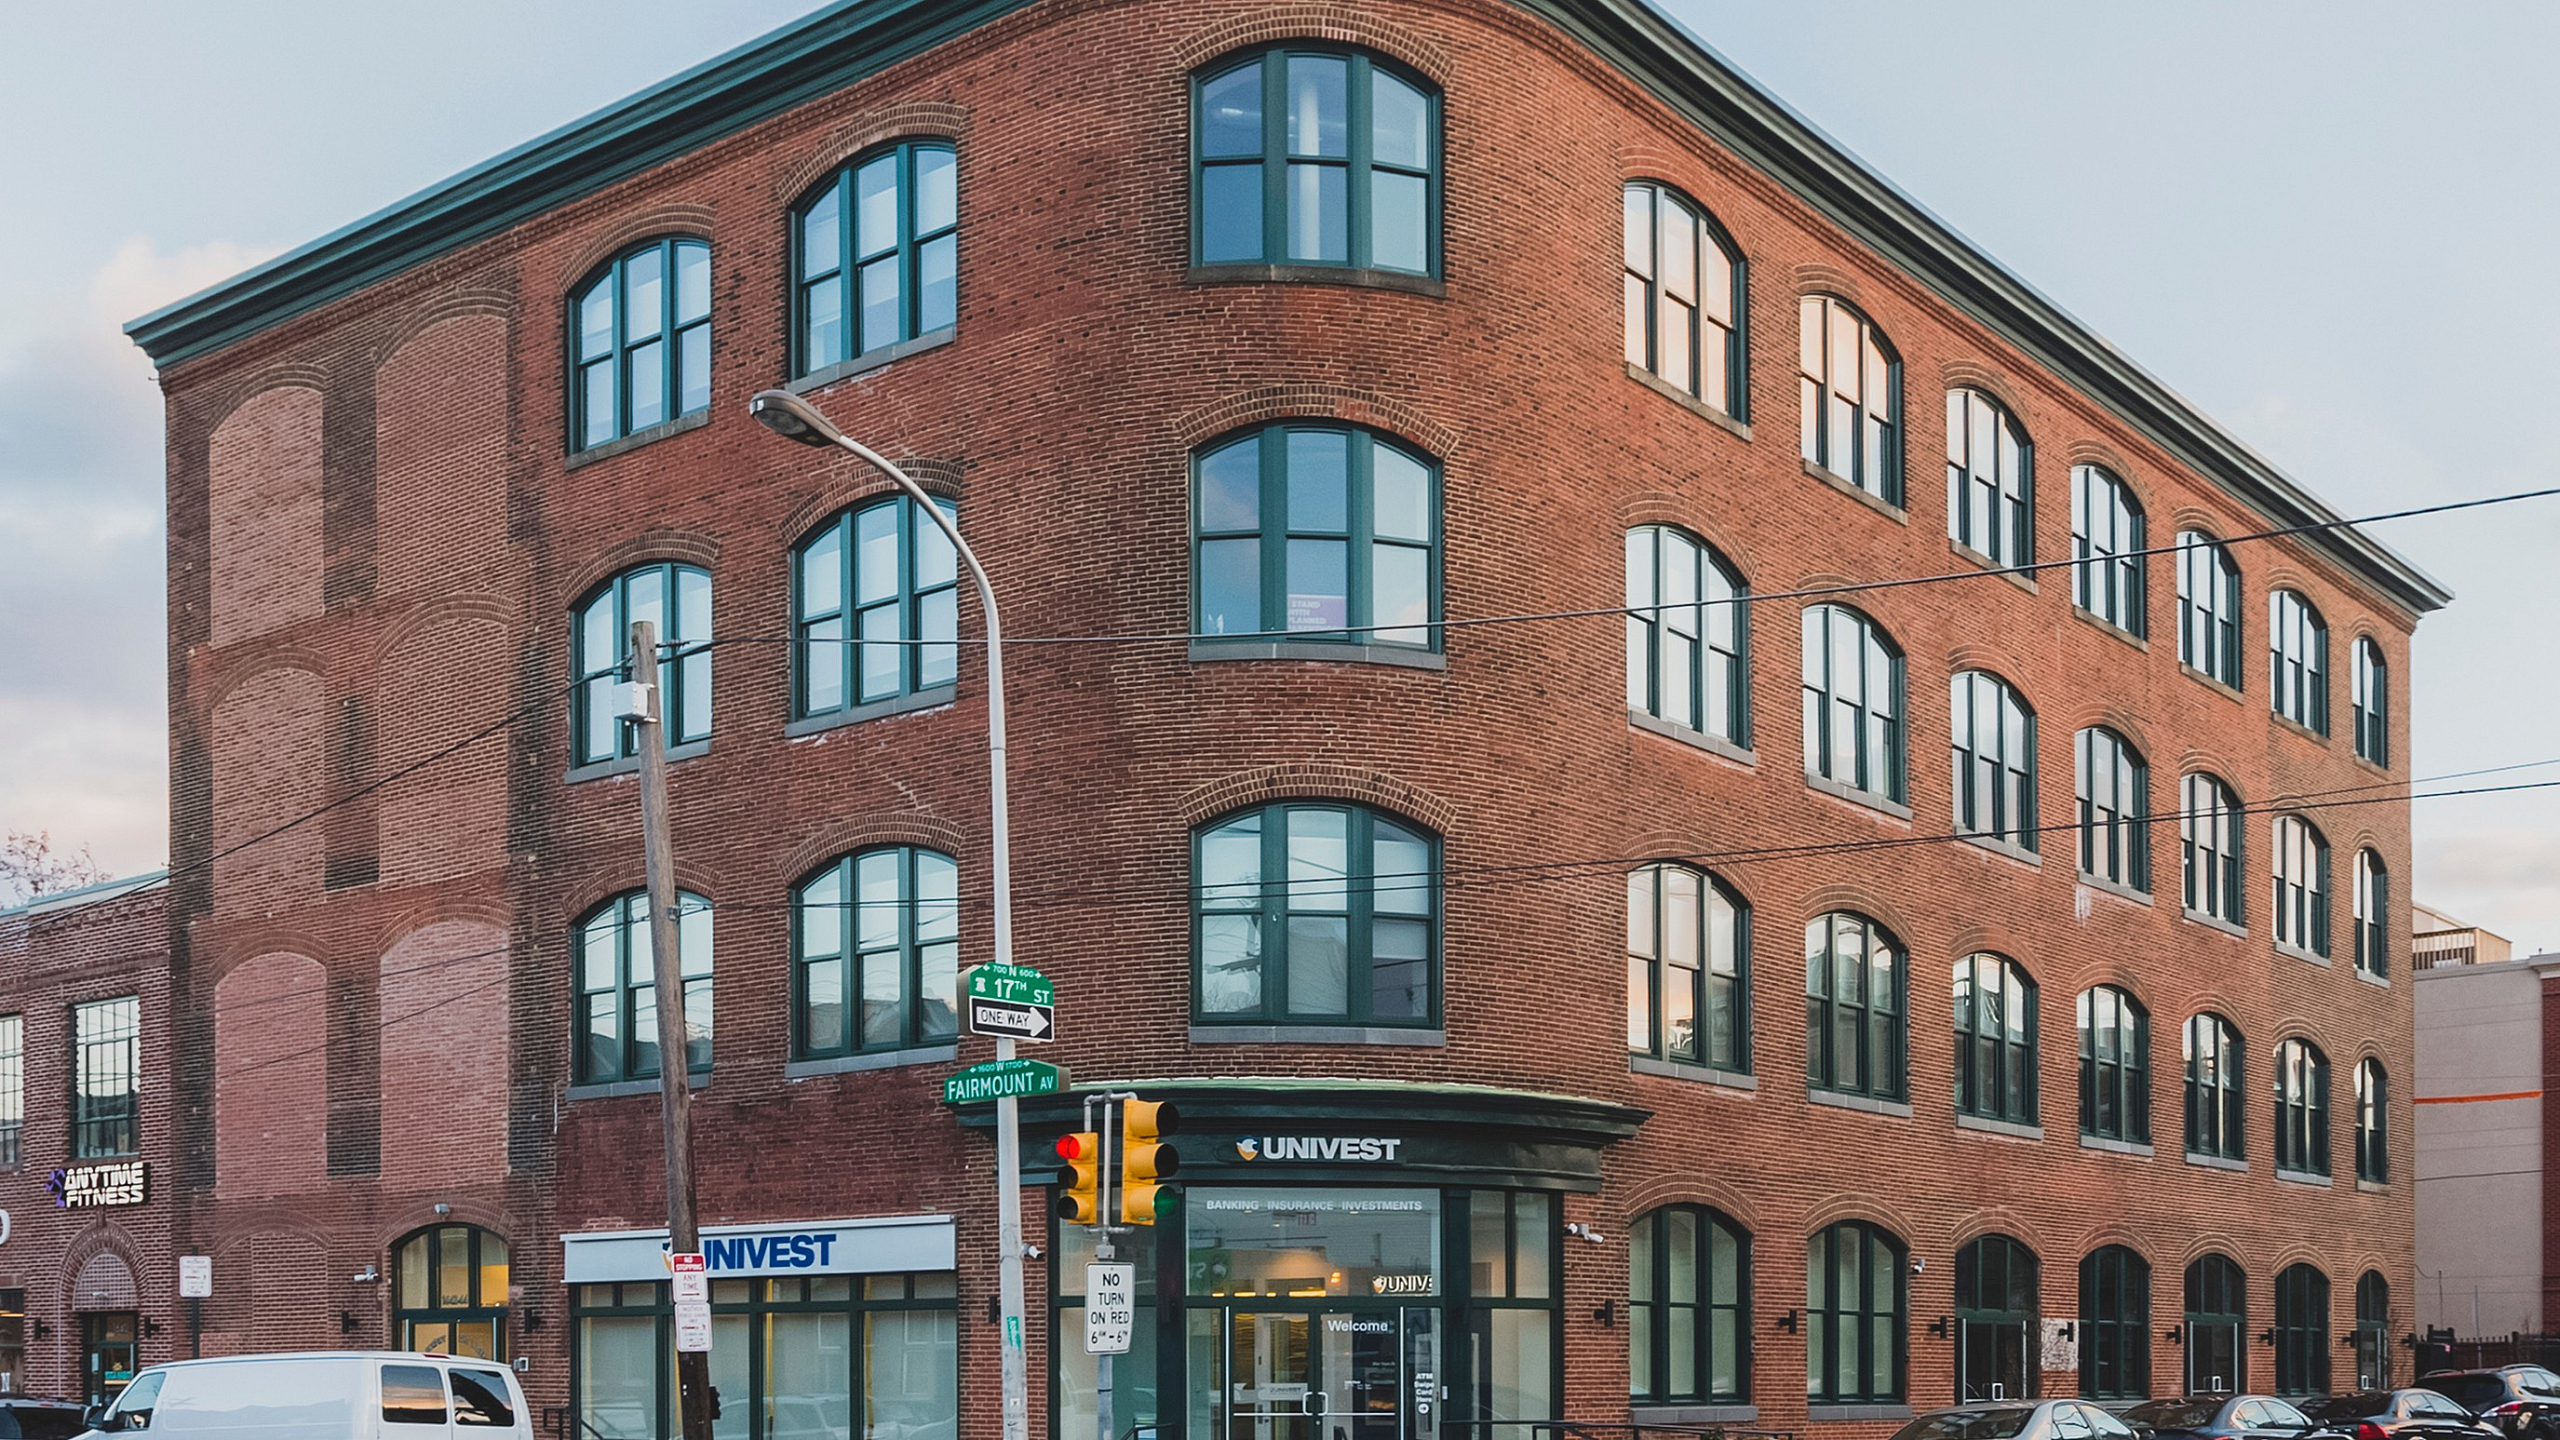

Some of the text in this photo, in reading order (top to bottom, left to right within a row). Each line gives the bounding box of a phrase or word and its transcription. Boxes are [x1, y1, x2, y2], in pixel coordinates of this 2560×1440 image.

[993, 965, 1034, 978] 700 N 600
[994, 978, 1050, 1004] 17TH ST
[980, 1009, 1030, 1027] ONE WAY
[978, 1061, 1022, 1073] 1600 W 1700
[948, 1072, 1054, 1100] FAIRMOUNT AV
[1263, 1137, 1401, 1161] UNIVEST
[64, 1161, 144, 1190] ANYTIME
[66, 1184, 144, 1208] FITNESS
[1206, 1200, 1422, 1210] BANKING INSURANCE INVESTMENTS
[1103, 1273, 1120, 1286] NO
[1098, 1292, 1125, 1306] TURN
[1091, 1311, 1130, 1325] ON RED
[1328, 1320, 1389, 1332] Welcome
[1414, 1381, 1435, 1389] Swipe
[1415, 1388, 1433, 1396] Card
